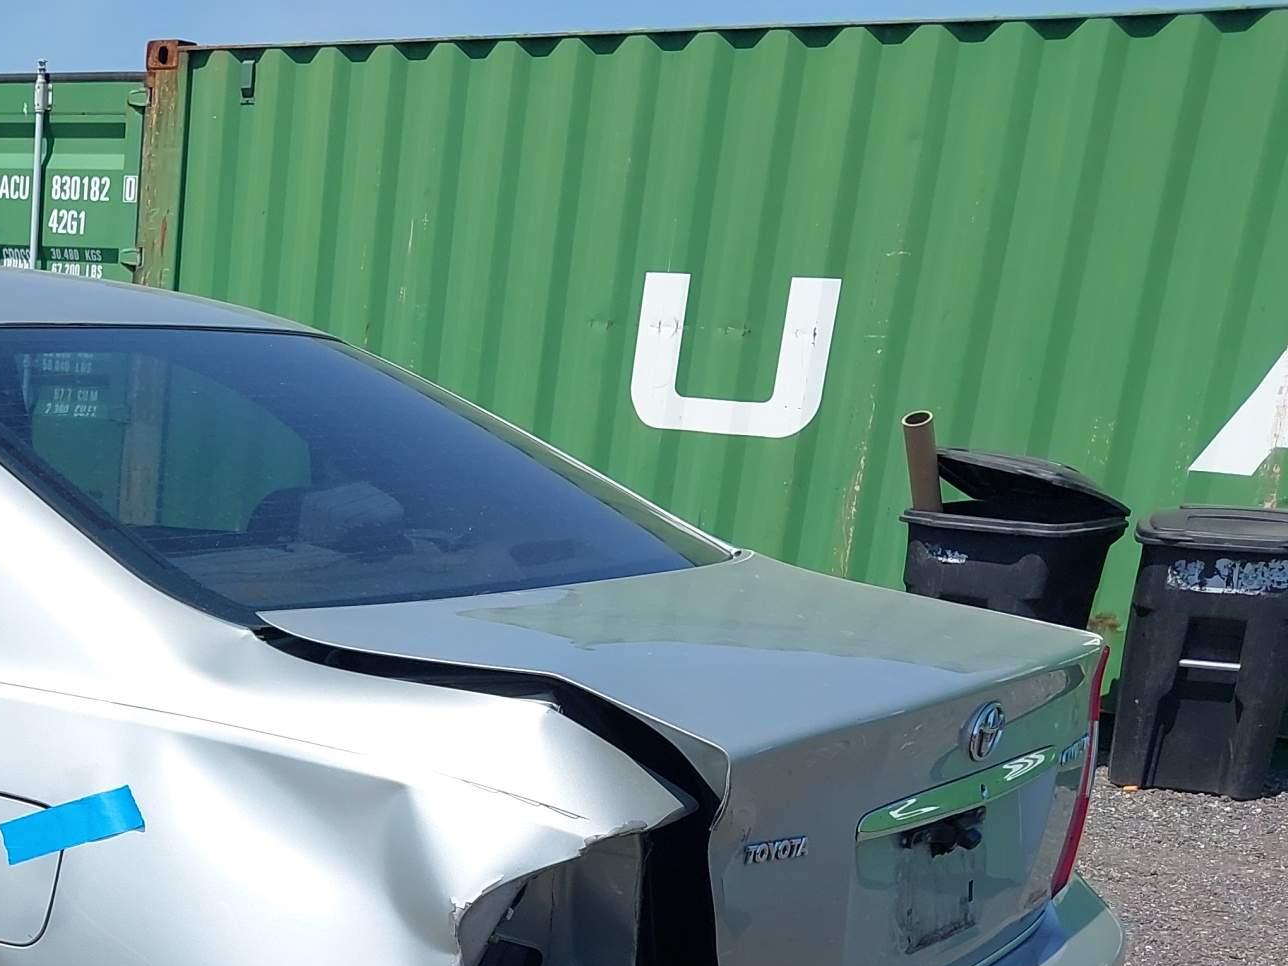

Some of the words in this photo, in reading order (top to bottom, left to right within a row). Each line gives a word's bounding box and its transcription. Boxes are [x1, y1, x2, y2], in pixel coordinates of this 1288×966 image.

[51, 175, 111, 202] 830182
[125, 176, 137, 202] 0
[47, 208, 87, 235] 42G1
[84, 249, 102, 262] KGS
[631, 271, 842, 439] U
[744, 835, 809, 866] TOYOTA
